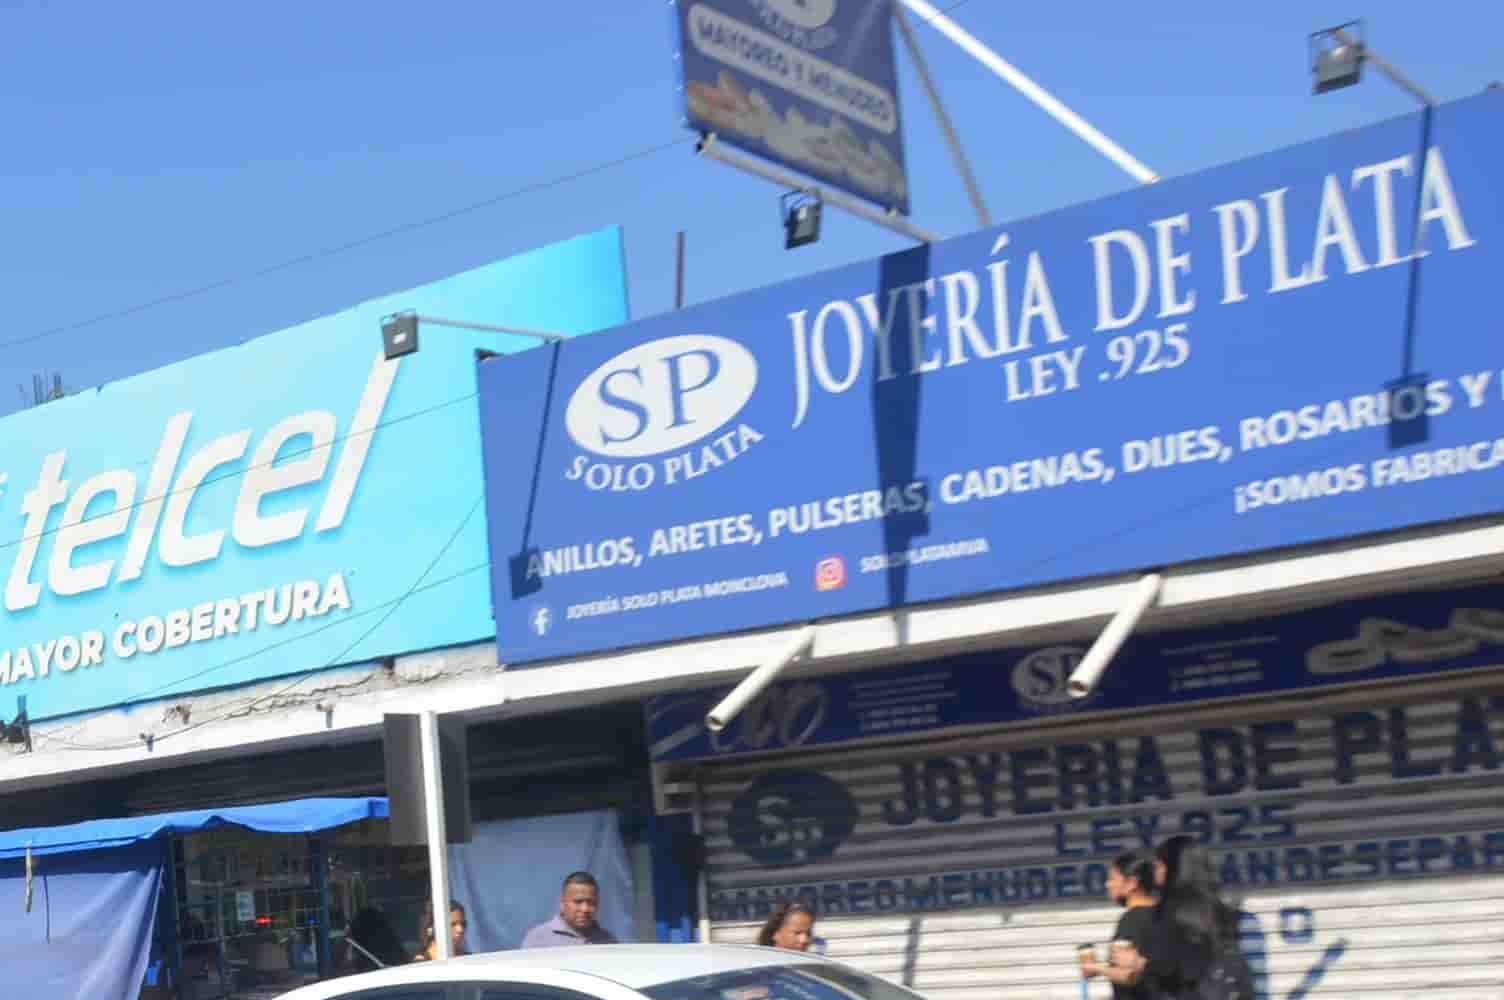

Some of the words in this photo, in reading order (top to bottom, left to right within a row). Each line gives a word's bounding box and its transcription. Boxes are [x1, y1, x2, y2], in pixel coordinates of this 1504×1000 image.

[787, 233, 1069, 430] JOYERÍA
[1088, 213, 1198, 333] DE
[1212, 146, 1478, 305] PLATA
[599, 349, 720, 448] SP
[1003, 344, 1086, 401] LEY
[1098, 322, 1191, 385] .925
[5, 352, 400, 613] telcel
[525, 534, 644, 580] ANILLOS,
[649, 512, 763, 559] ARETES,
[768, 480, 934, 538] PULSERAS,
[939, 447, 1116, 503] CADENAS,
[1239, 379, 1453, 452] ROSARIOS
[1458, 369, 1494, 410] Y
[564, 454, 656, 493] SOLO
[662, 422, 765, 486] PLATA
[112, 573, 352, 659] COBERTURA
[622, 590, 659, 611] SOLO
[660, 583, 703, 607] PLATA
[880, 734, 1174, 826] JOYERIA
[1198, 716, 1302, 798] DE
[1053, 812, 1162, 858] LEY
